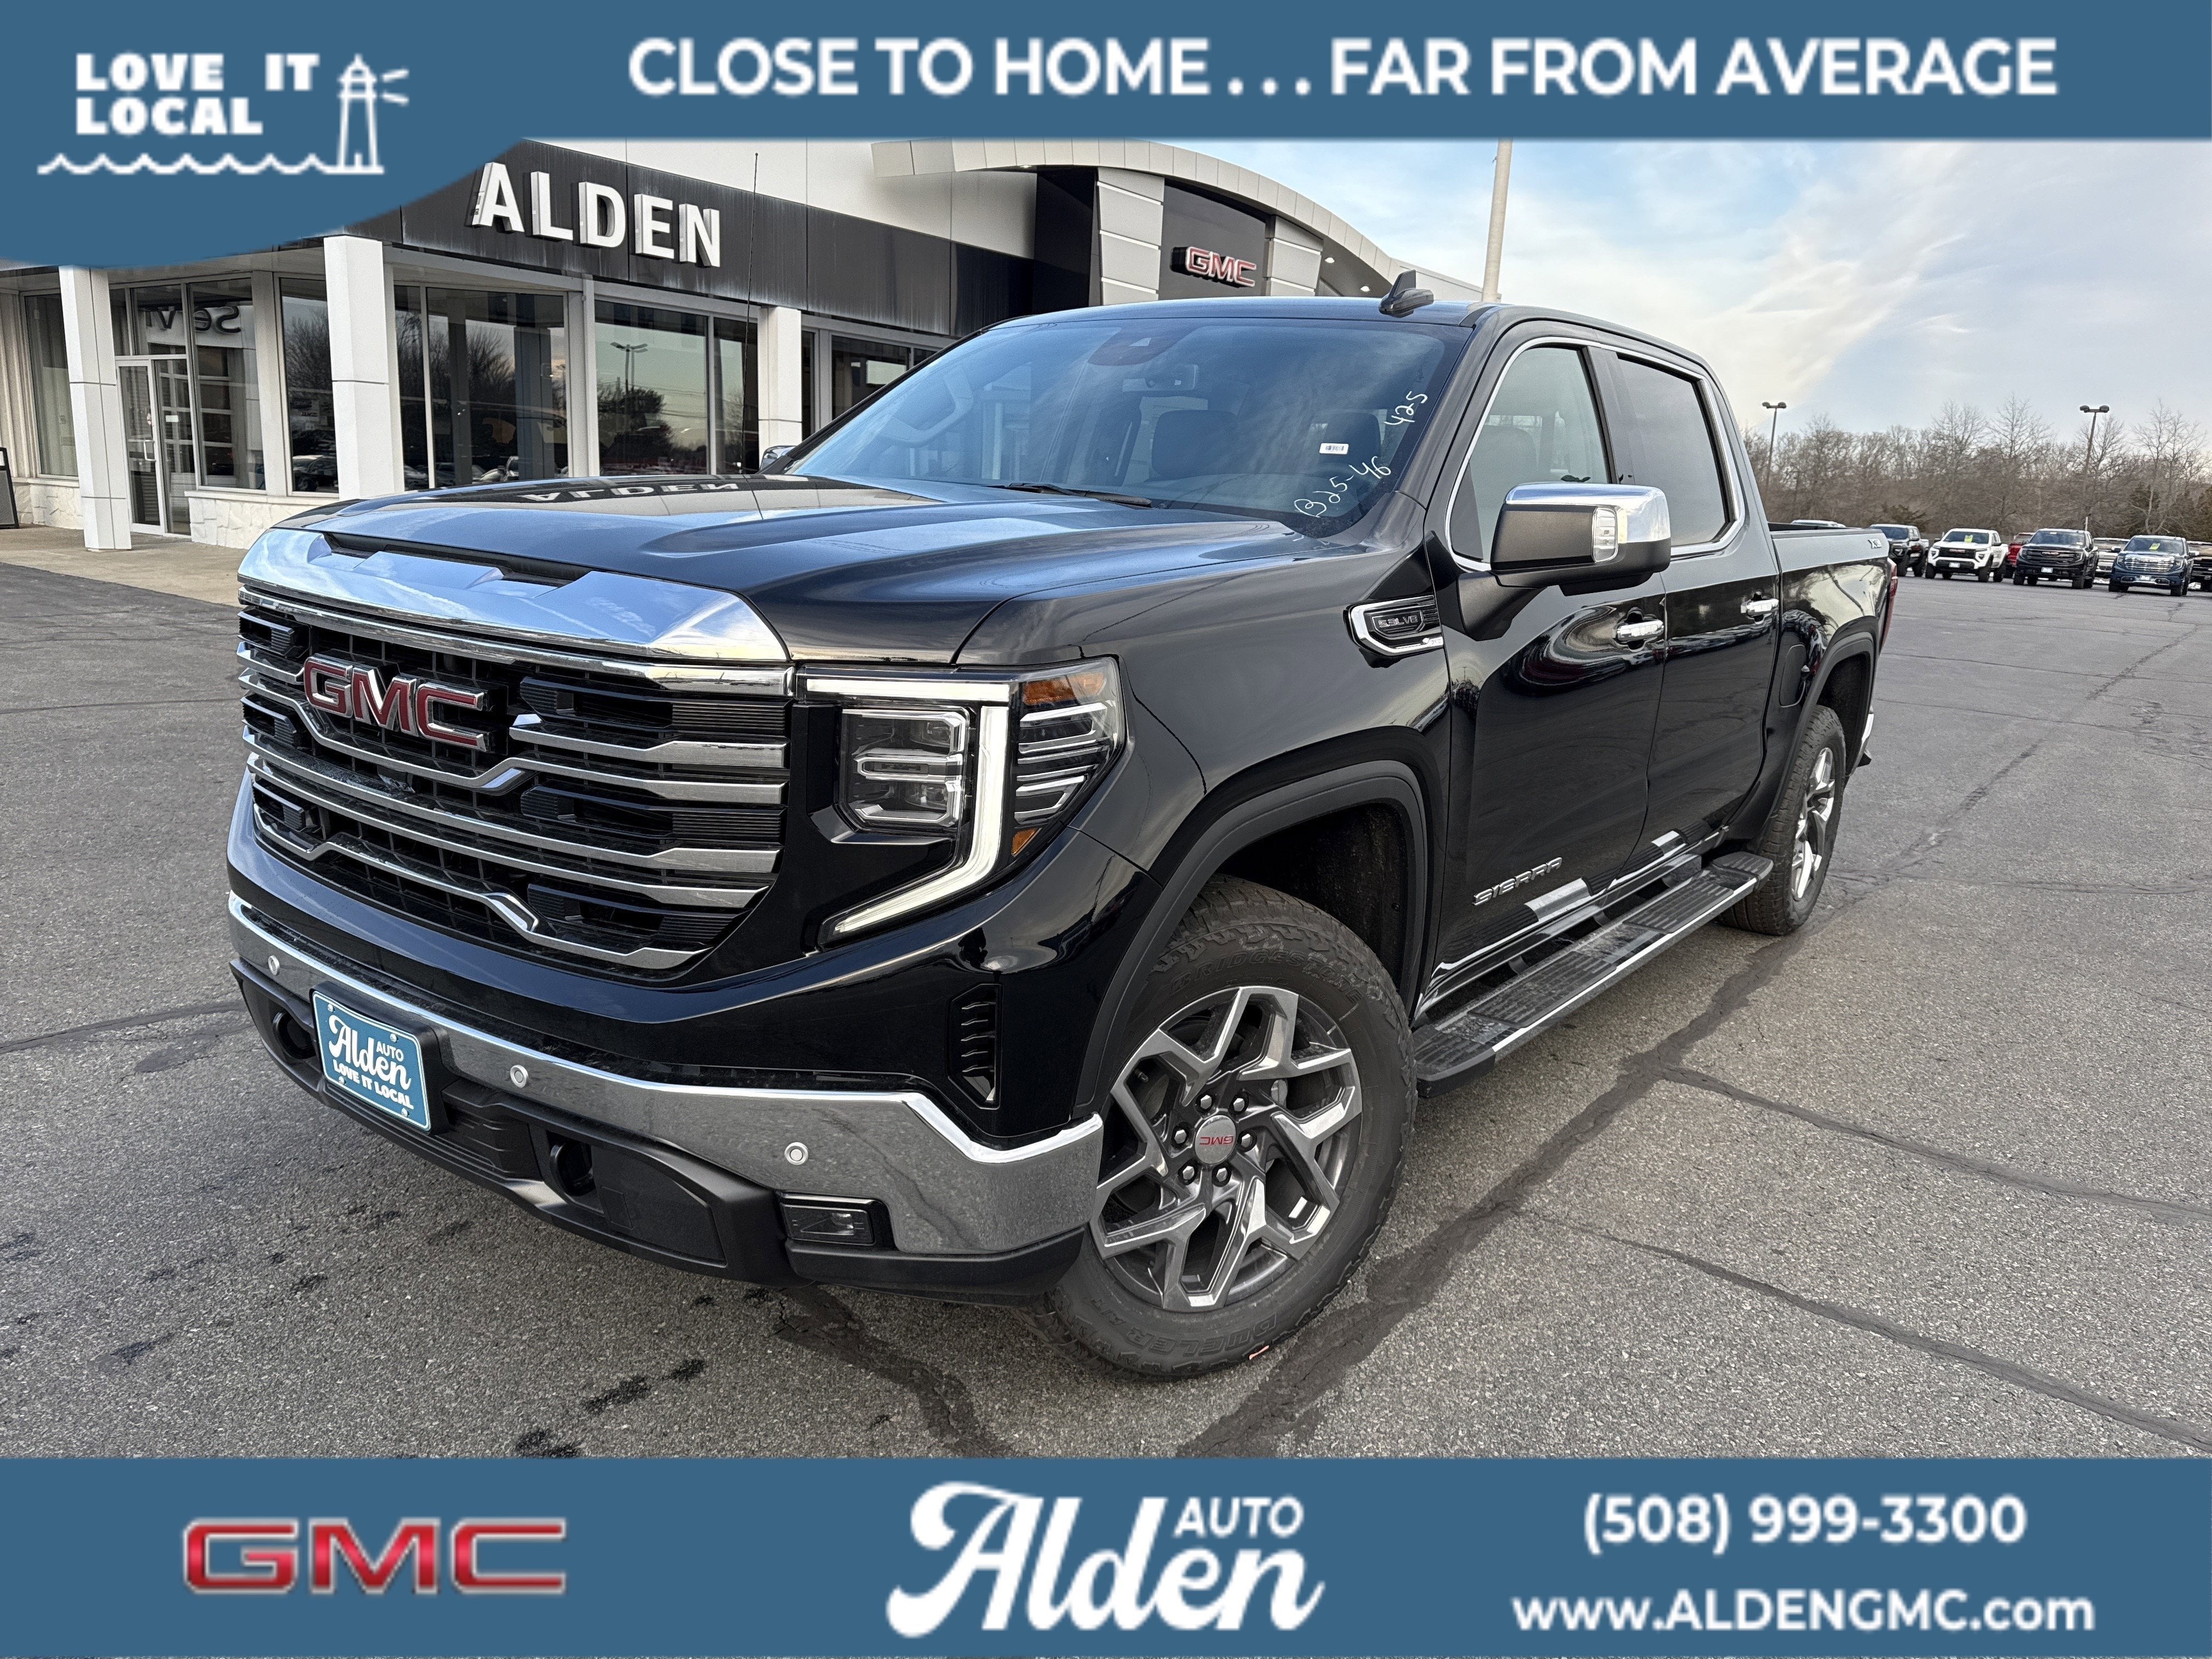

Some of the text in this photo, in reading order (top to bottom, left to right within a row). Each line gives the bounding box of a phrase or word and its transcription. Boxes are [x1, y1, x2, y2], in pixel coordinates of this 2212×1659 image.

[472, 162, 720, 267] ALDEN
[1186, 247, 1257, 287] GMC
[1383, 391, 1428, 425] 425
[303, 653, 487, 752] GMC
[1472, 857, 1562, 905] SIERRA
[329, 1014, 411, 1090] Alden
[376, 1041, 404, 1062] AUTO
[332, 1059, 414, 1110] LOVE IT LOCAL
[1199, 1136, 1233, 1146] GMC
